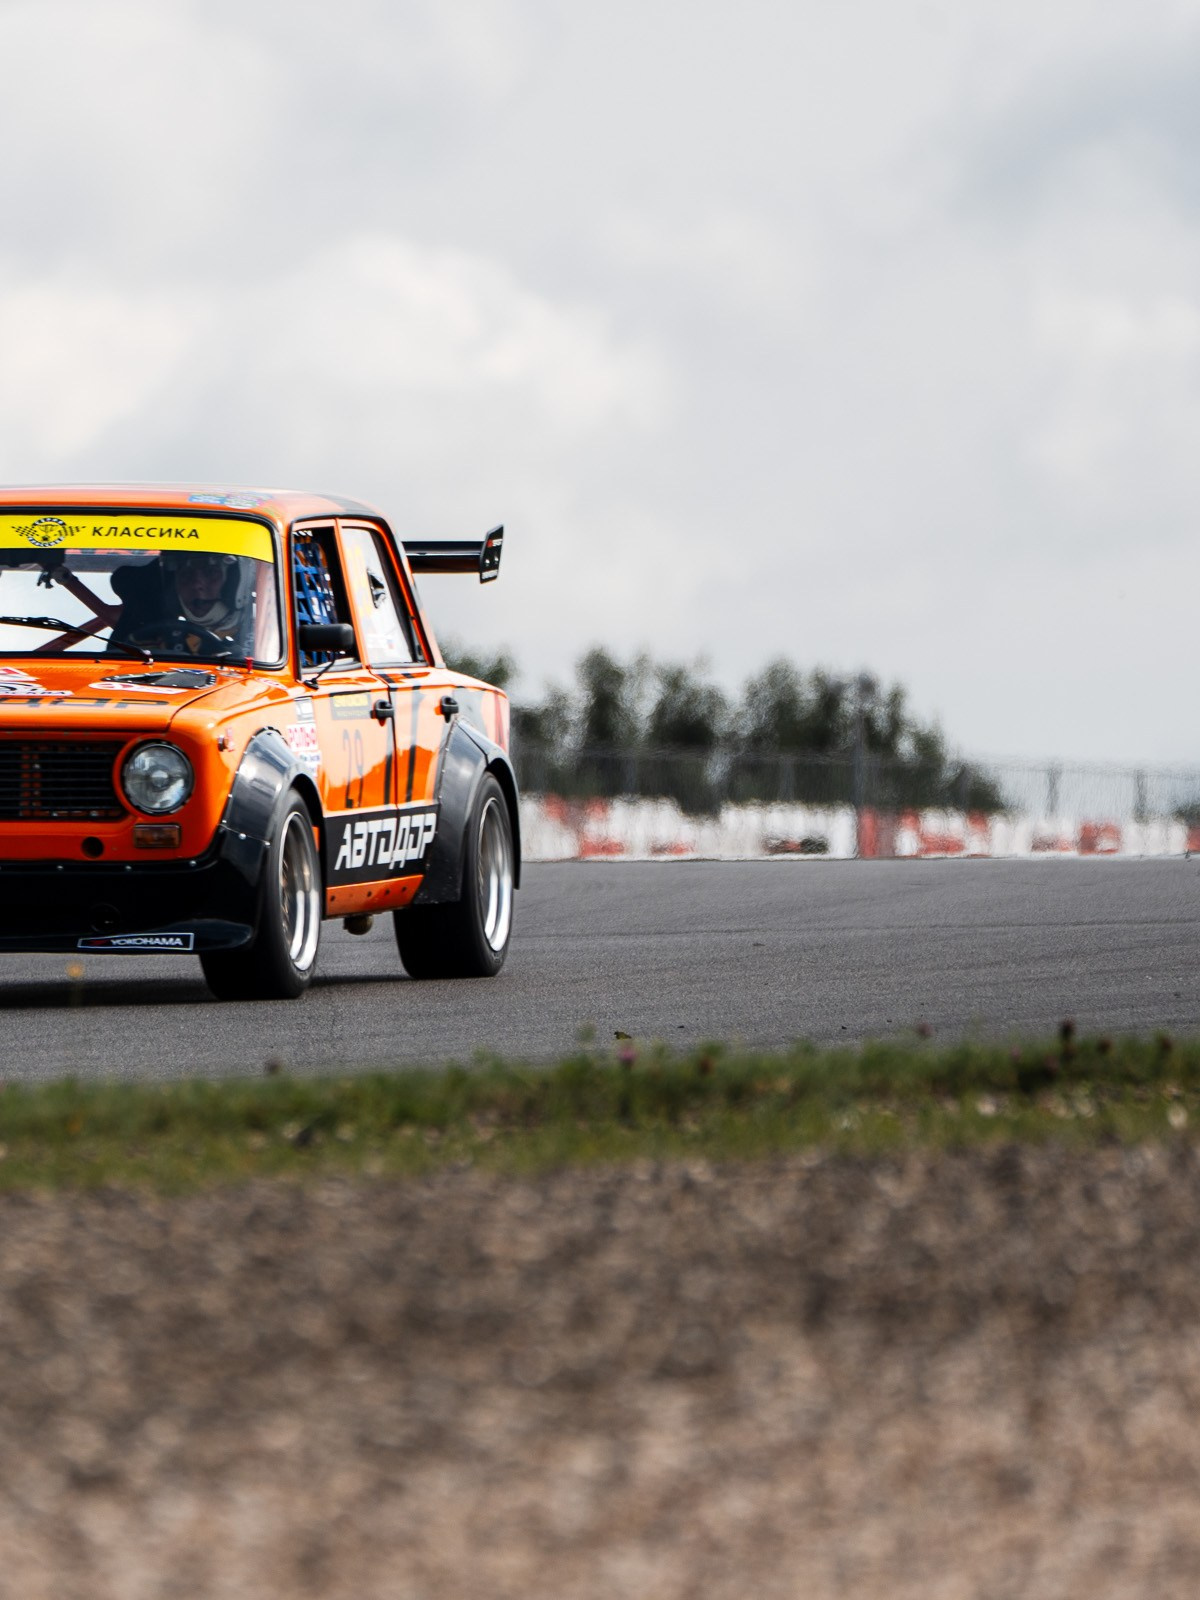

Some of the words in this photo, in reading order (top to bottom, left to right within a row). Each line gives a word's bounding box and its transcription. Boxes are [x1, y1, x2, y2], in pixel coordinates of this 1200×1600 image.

[91, 526, 200, 539] КЛАССИКА
[334, 813, 437, 870] АВТОДОР
[110, 937, 184, 946] YOKOHAMA
